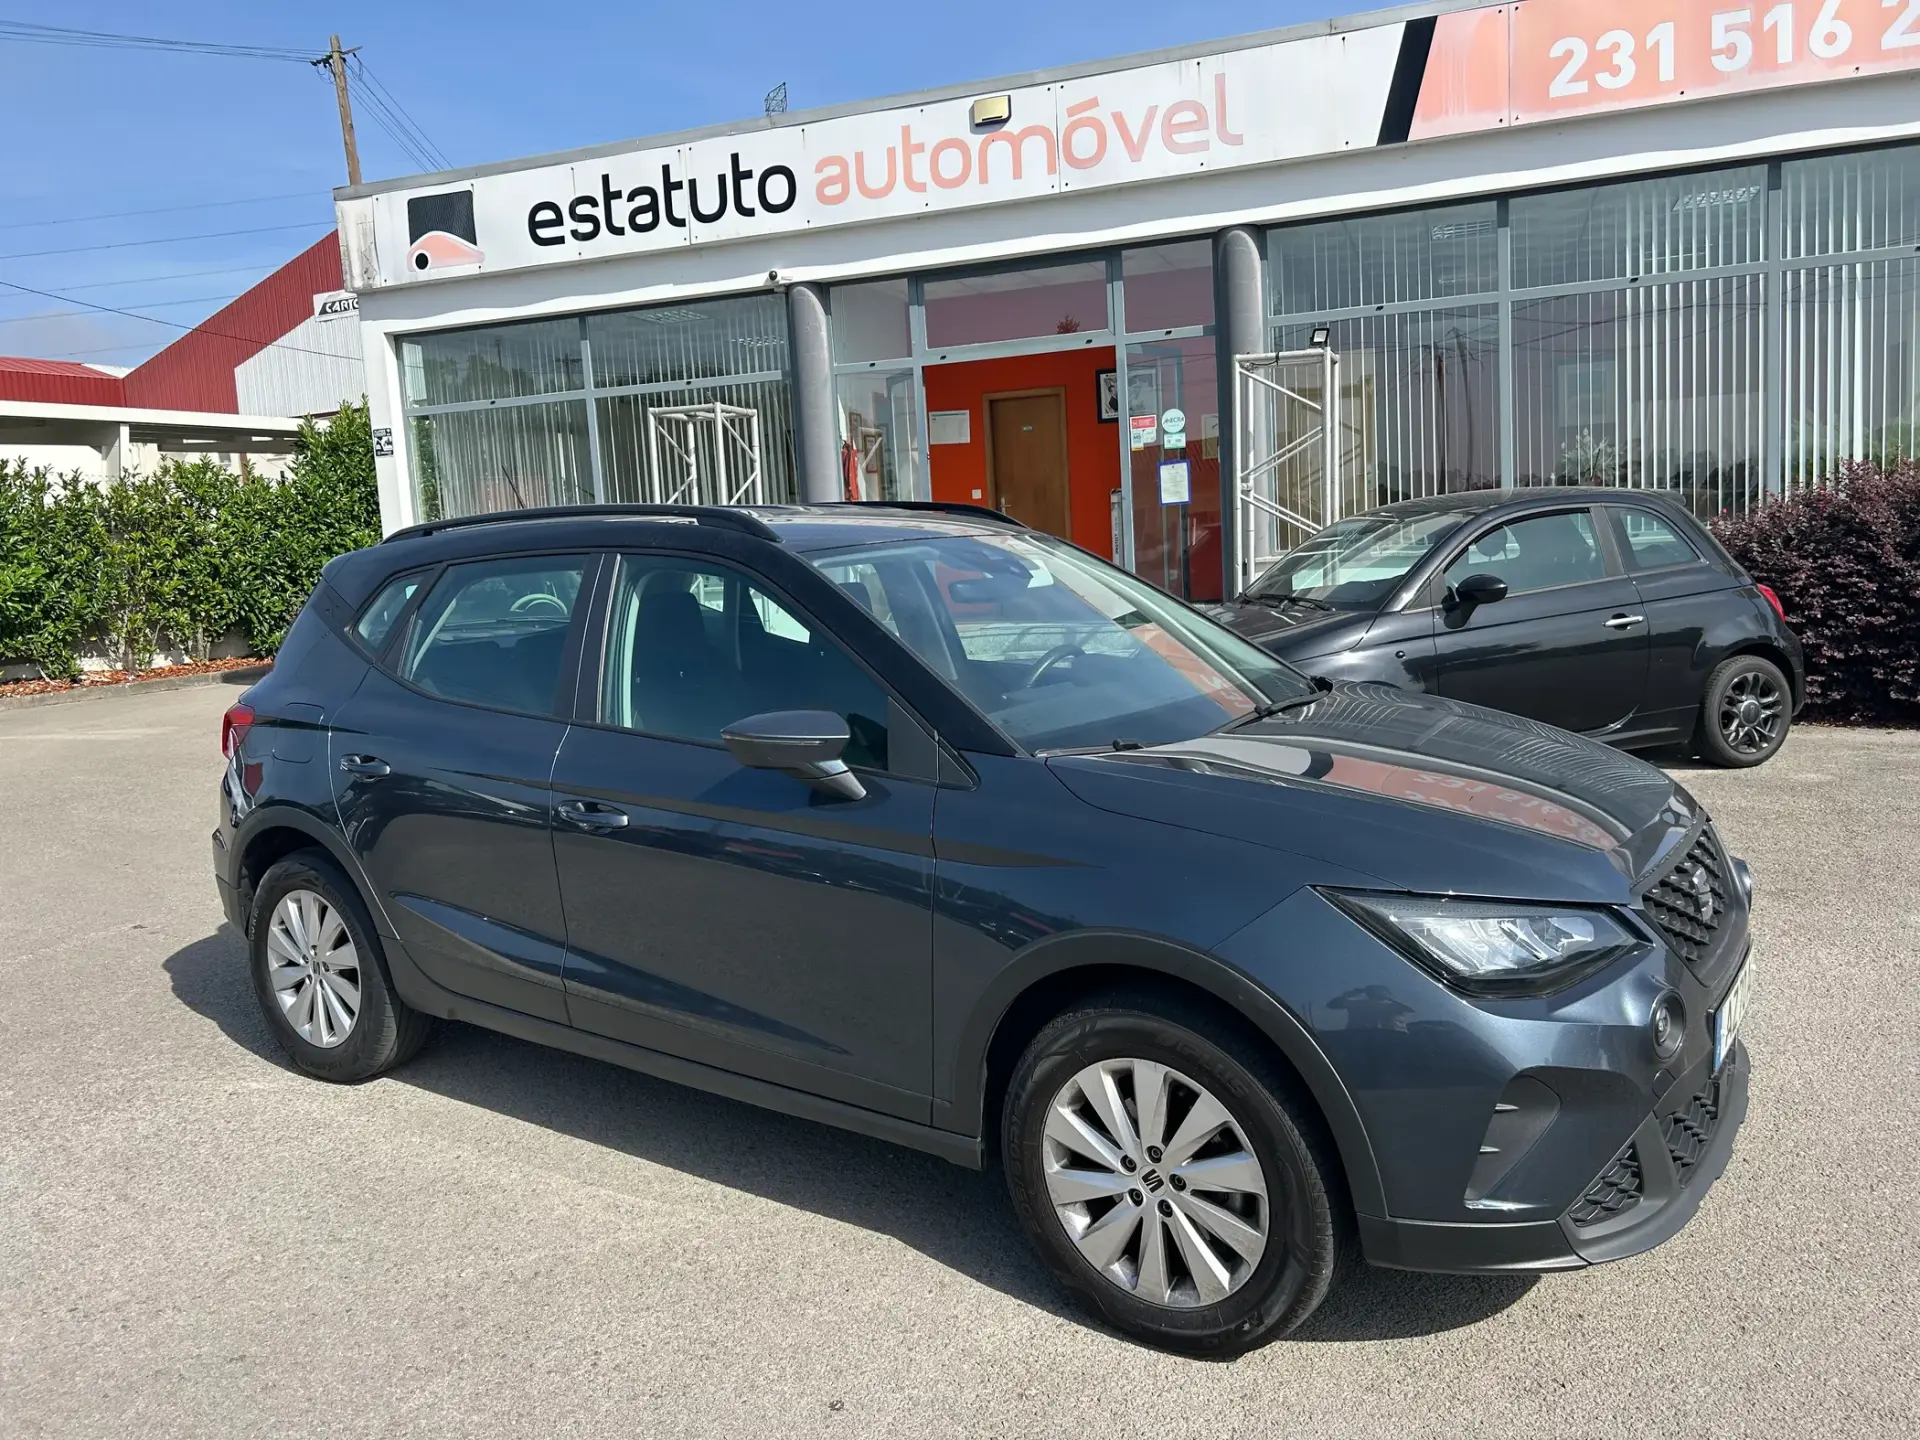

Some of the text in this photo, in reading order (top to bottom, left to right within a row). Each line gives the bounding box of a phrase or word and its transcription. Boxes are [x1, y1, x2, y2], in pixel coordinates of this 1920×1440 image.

[1548, 22, 1675, 98] 231
[1710, 0, 1853, 72] 516
[527, 72, 1244, 247] estatuto automóvel
